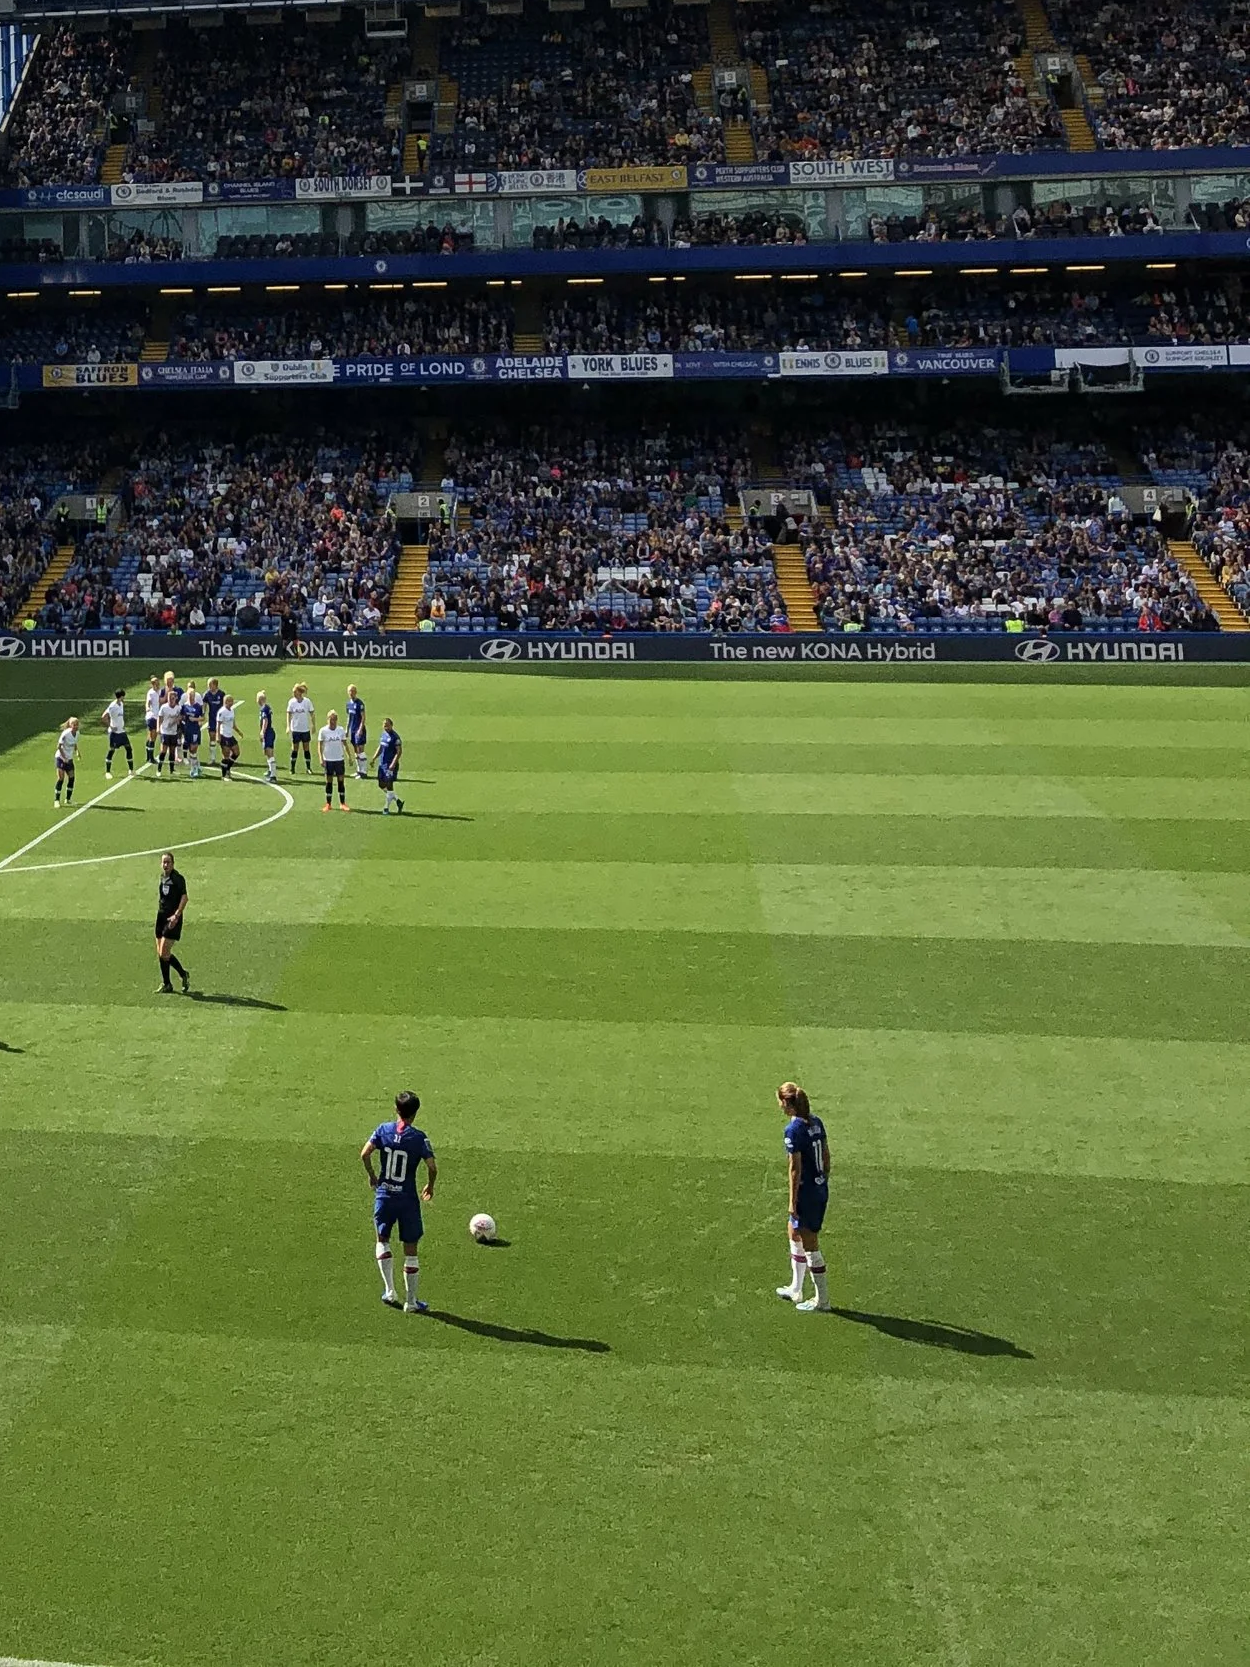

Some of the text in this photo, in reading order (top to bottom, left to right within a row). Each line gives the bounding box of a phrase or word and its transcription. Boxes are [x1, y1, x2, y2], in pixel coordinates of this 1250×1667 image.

[791, 160, 892, 176] SOUTH WEST
[313, 176, 373, 192] SOUTH DORSET
[590, 172, 664, 184] EAST BELFAST
[56, 187, 104, 201] cfcsaudi
[283, 363, 308, 372] Dublin
[346, 363, 394, 376] PRIDE
[401, 363, 416, 372] OF
[420, 363, 465, 375] LOND
[495, 357, 563, 368] ADELAIDE
[581, 357, 658, 371] YORK BLUES
[795, 358, 872, 368] ENNIS BLUES
[916, 358, 996, 369] VANCOUVER
[76, 366, 128, 374] SAFFRON
[264, 372, 327, 381] Supporters Club
[499, 368, 562, 379] CHELSEA
[76, 373, 129, 384] BLUES
[31, 640, 130, 657] HYUNDAI
[198, 640, 233, 656] The
[238, 644, 277, 656] new
[343, 640, 407, 660] Hybrid
[527, 641, 636, 659] HYUNDAI
[709, 642, 936, 662] The new KONA Hybrid
[1066, 642, 1184, 661] HYUNDAI
[812, 1139, 824, 1172] 11
[384, 1146, 408, 1183] 10
